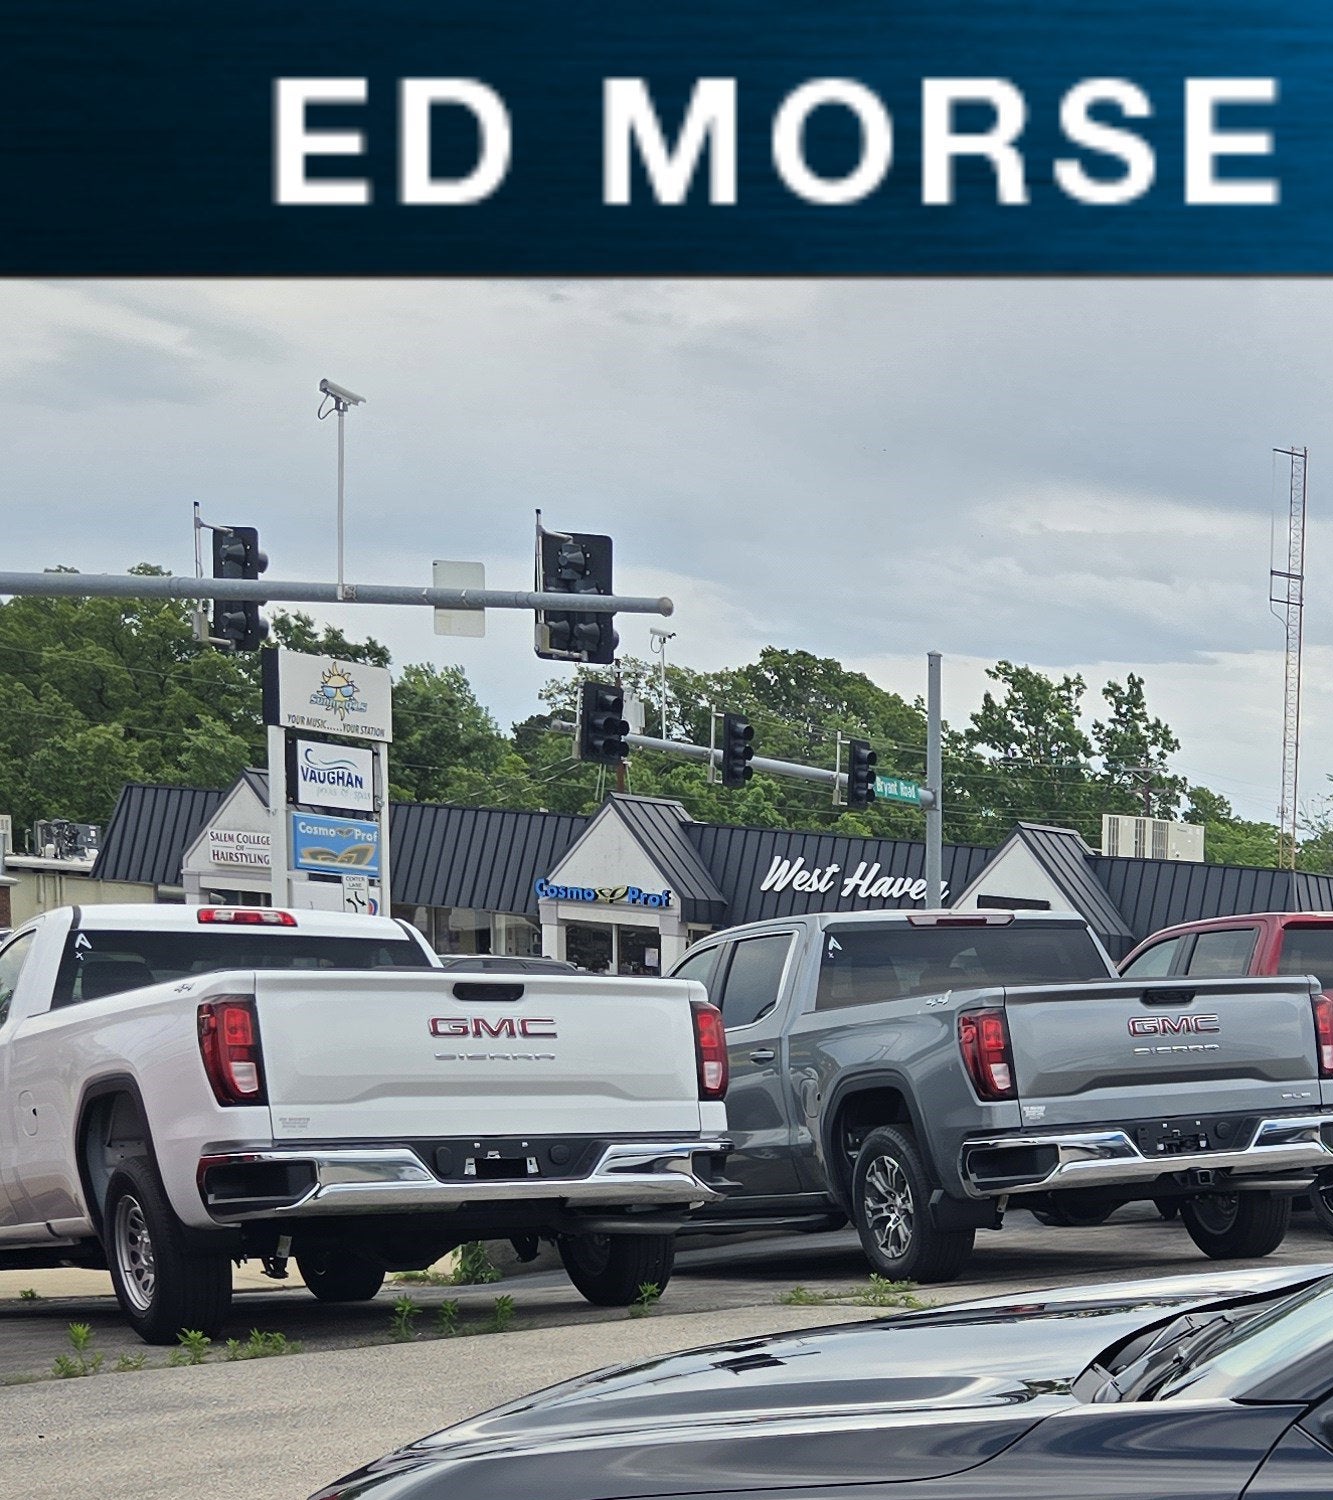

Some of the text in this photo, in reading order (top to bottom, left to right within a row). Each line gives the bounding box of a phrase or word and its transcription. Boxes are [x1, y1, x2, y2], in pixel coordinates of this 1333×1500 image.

[287, 714, 305, 726] YOUR
[342, 723, 359, 735] YOUR
[359, 725, 385, 737] STATION
[300, 765, 363, 789] VAUGHAN
[209, 831, 271, 846] SALEM COLLEGE
[299, 822, 378, 842] Cosmo Prof
[212, 849, 270, 865] HAIRSTYLING
[760, 855, 840, 892] West
[534, 878, 671, 908] Cosmo Prof
[428, 1015, 558, 1039] GMC
[1128, 1013, 1220, 1037] GMC
